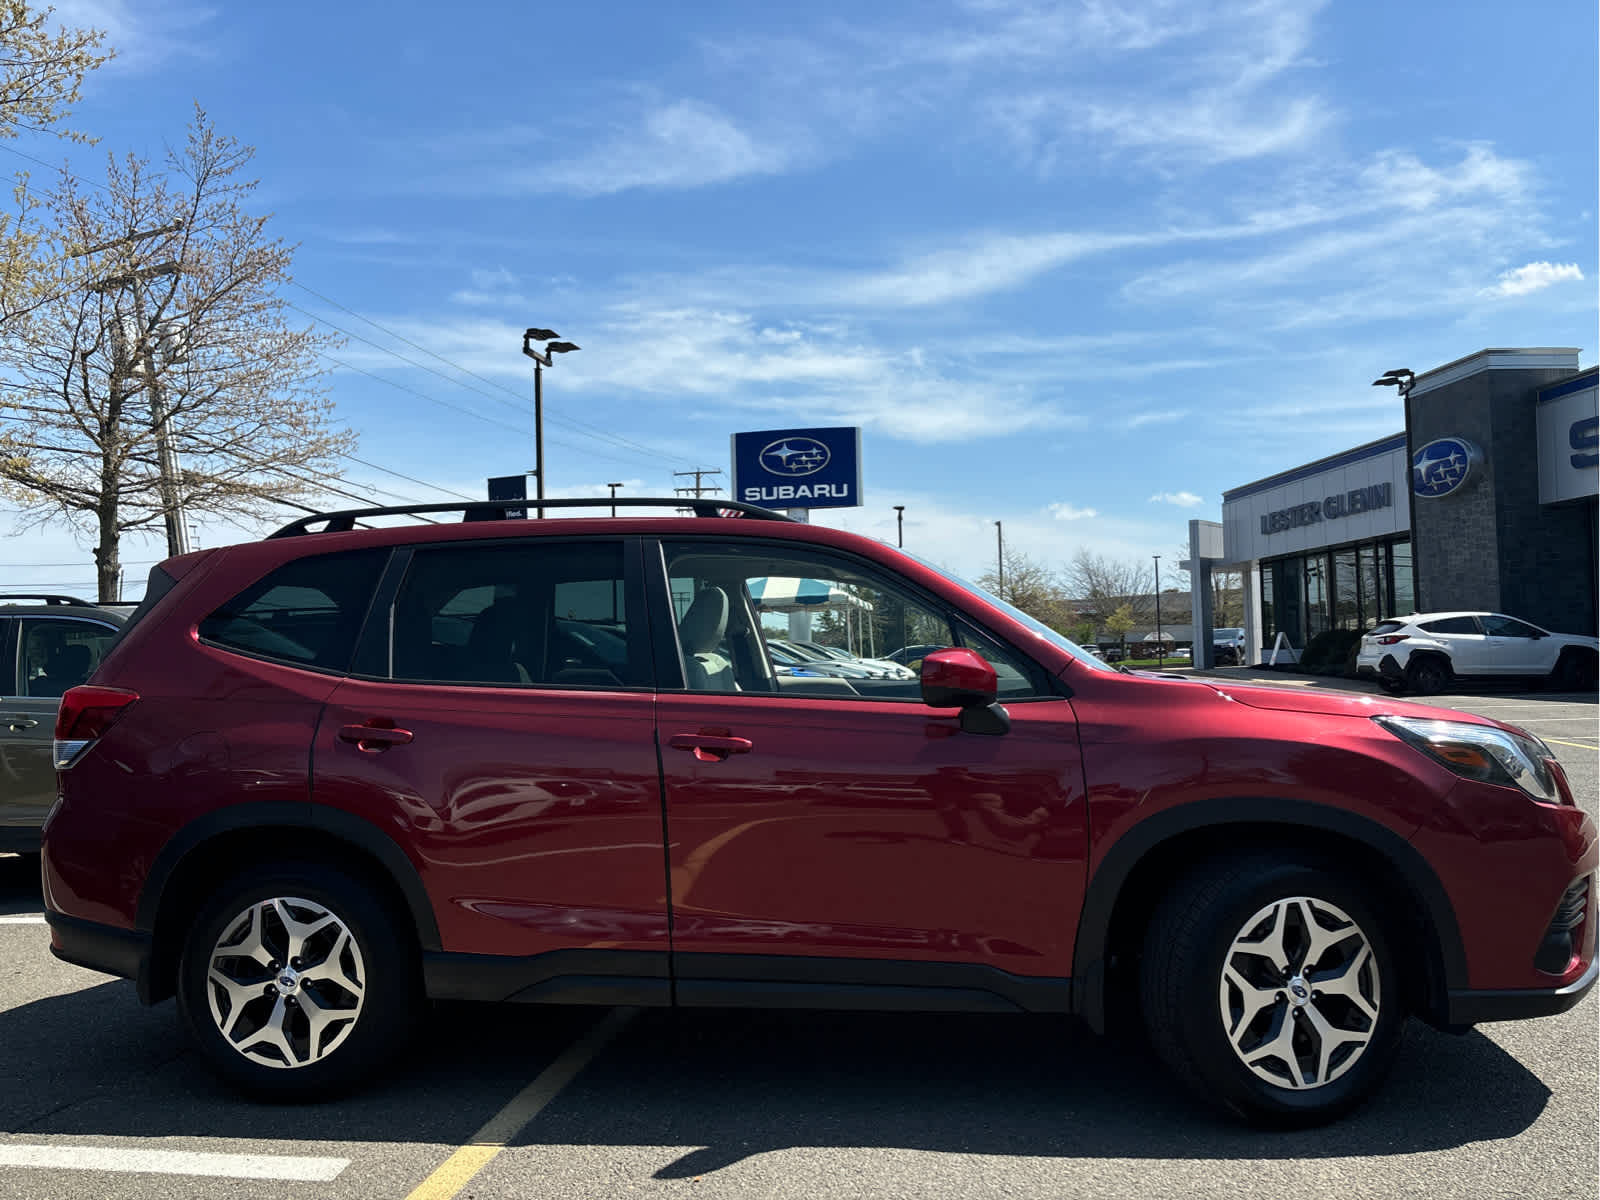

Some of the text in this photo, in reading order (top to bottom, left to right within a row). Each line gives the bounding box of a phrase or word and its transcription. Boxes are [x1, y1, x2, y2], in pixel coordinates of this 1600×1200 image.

[744, 483, 848, 501] SUBARU
[1260, 482, 1392, 535] LESTER GLENN
